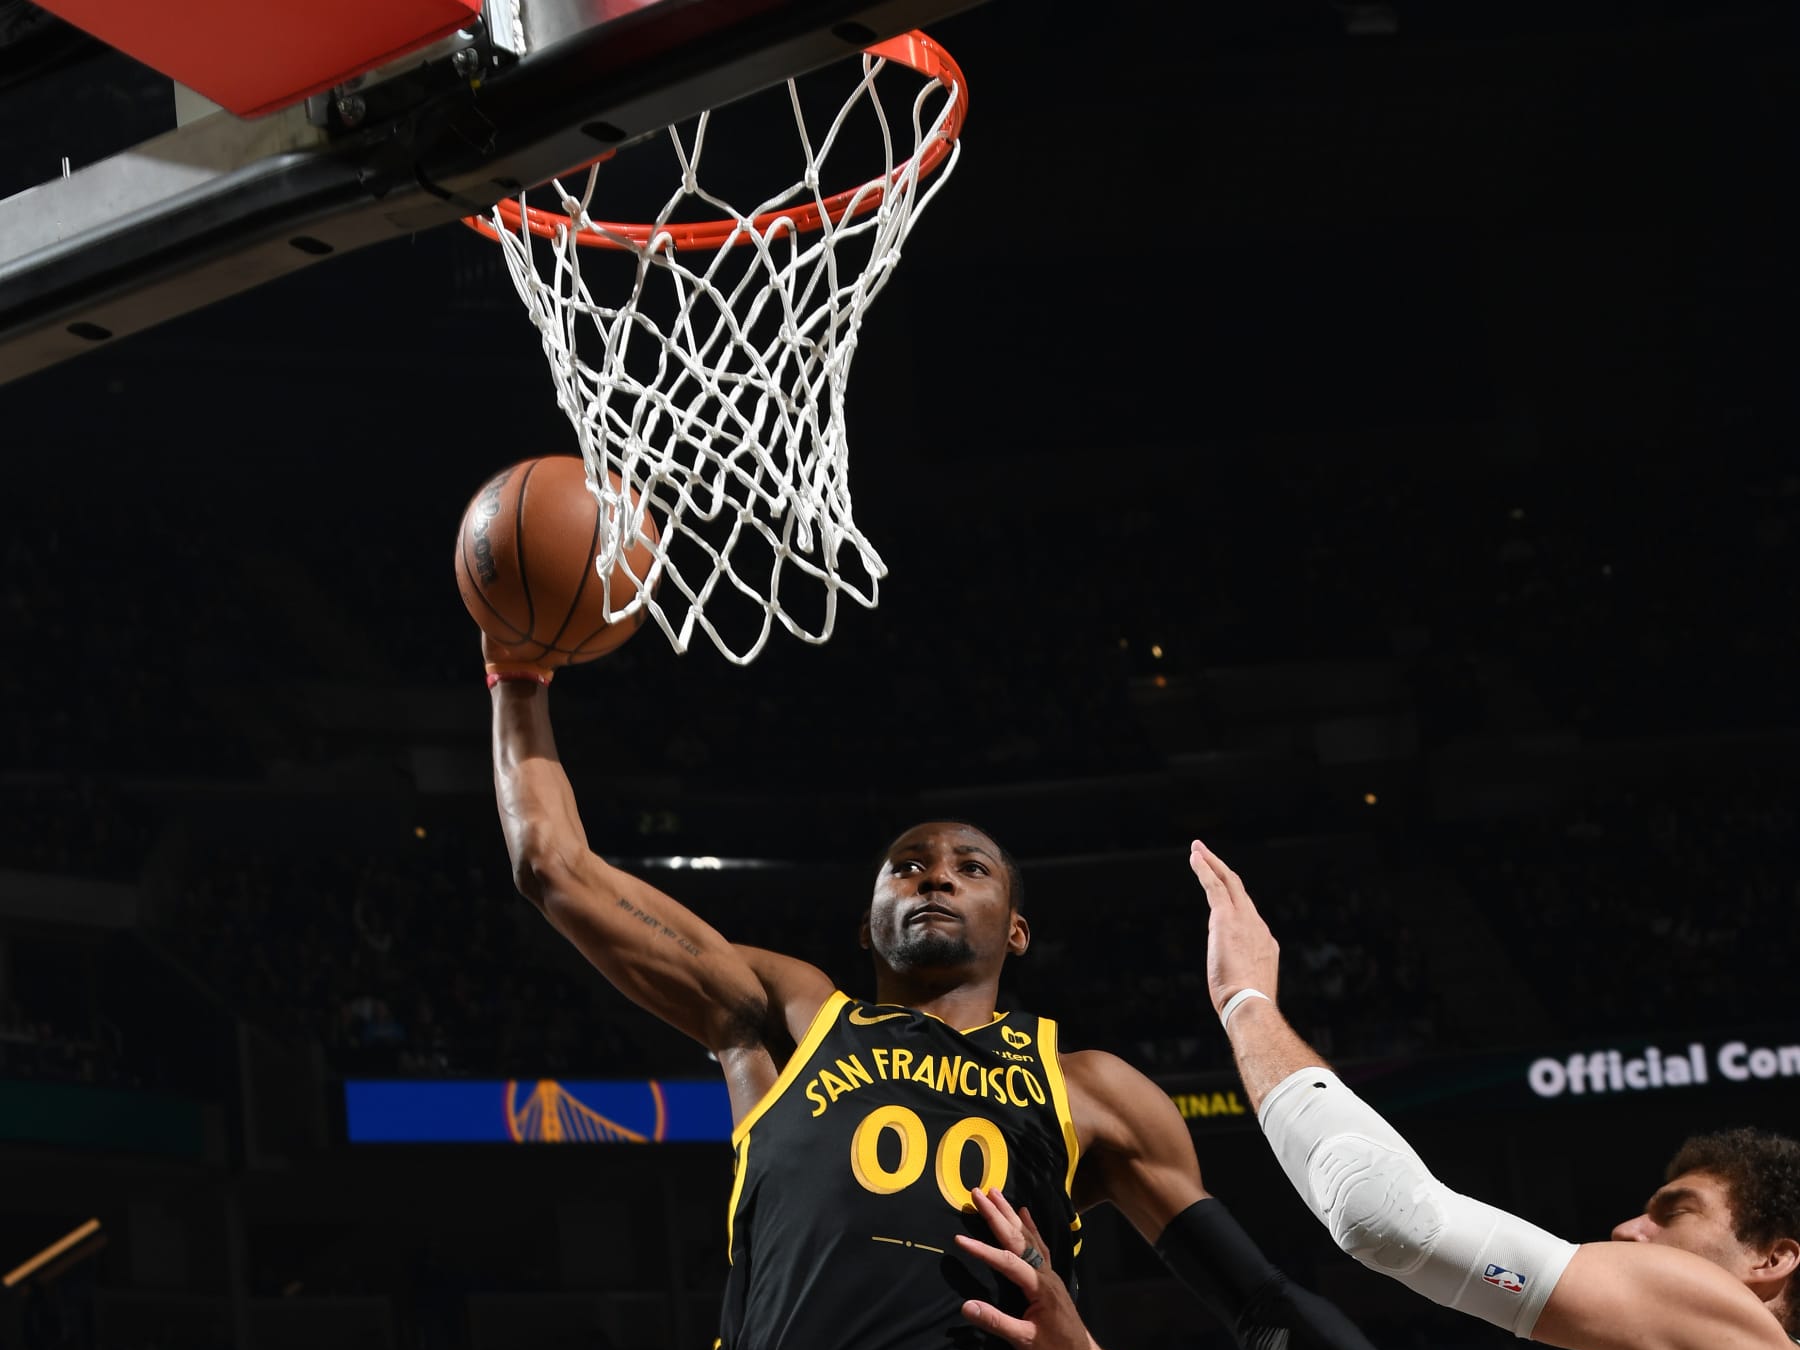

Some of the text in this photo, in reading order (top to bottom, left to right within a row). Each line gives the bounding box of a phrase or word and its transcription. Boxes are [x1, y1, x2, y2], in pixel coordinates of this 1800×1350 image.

[804, 1047, 1047, 1118] SAN FRANCISCO
[1529, 1043, 1707, 1096] Official
[1172, 1092, 1246, 1119] INAL
[850, 1104, 1009, 1215] 00
